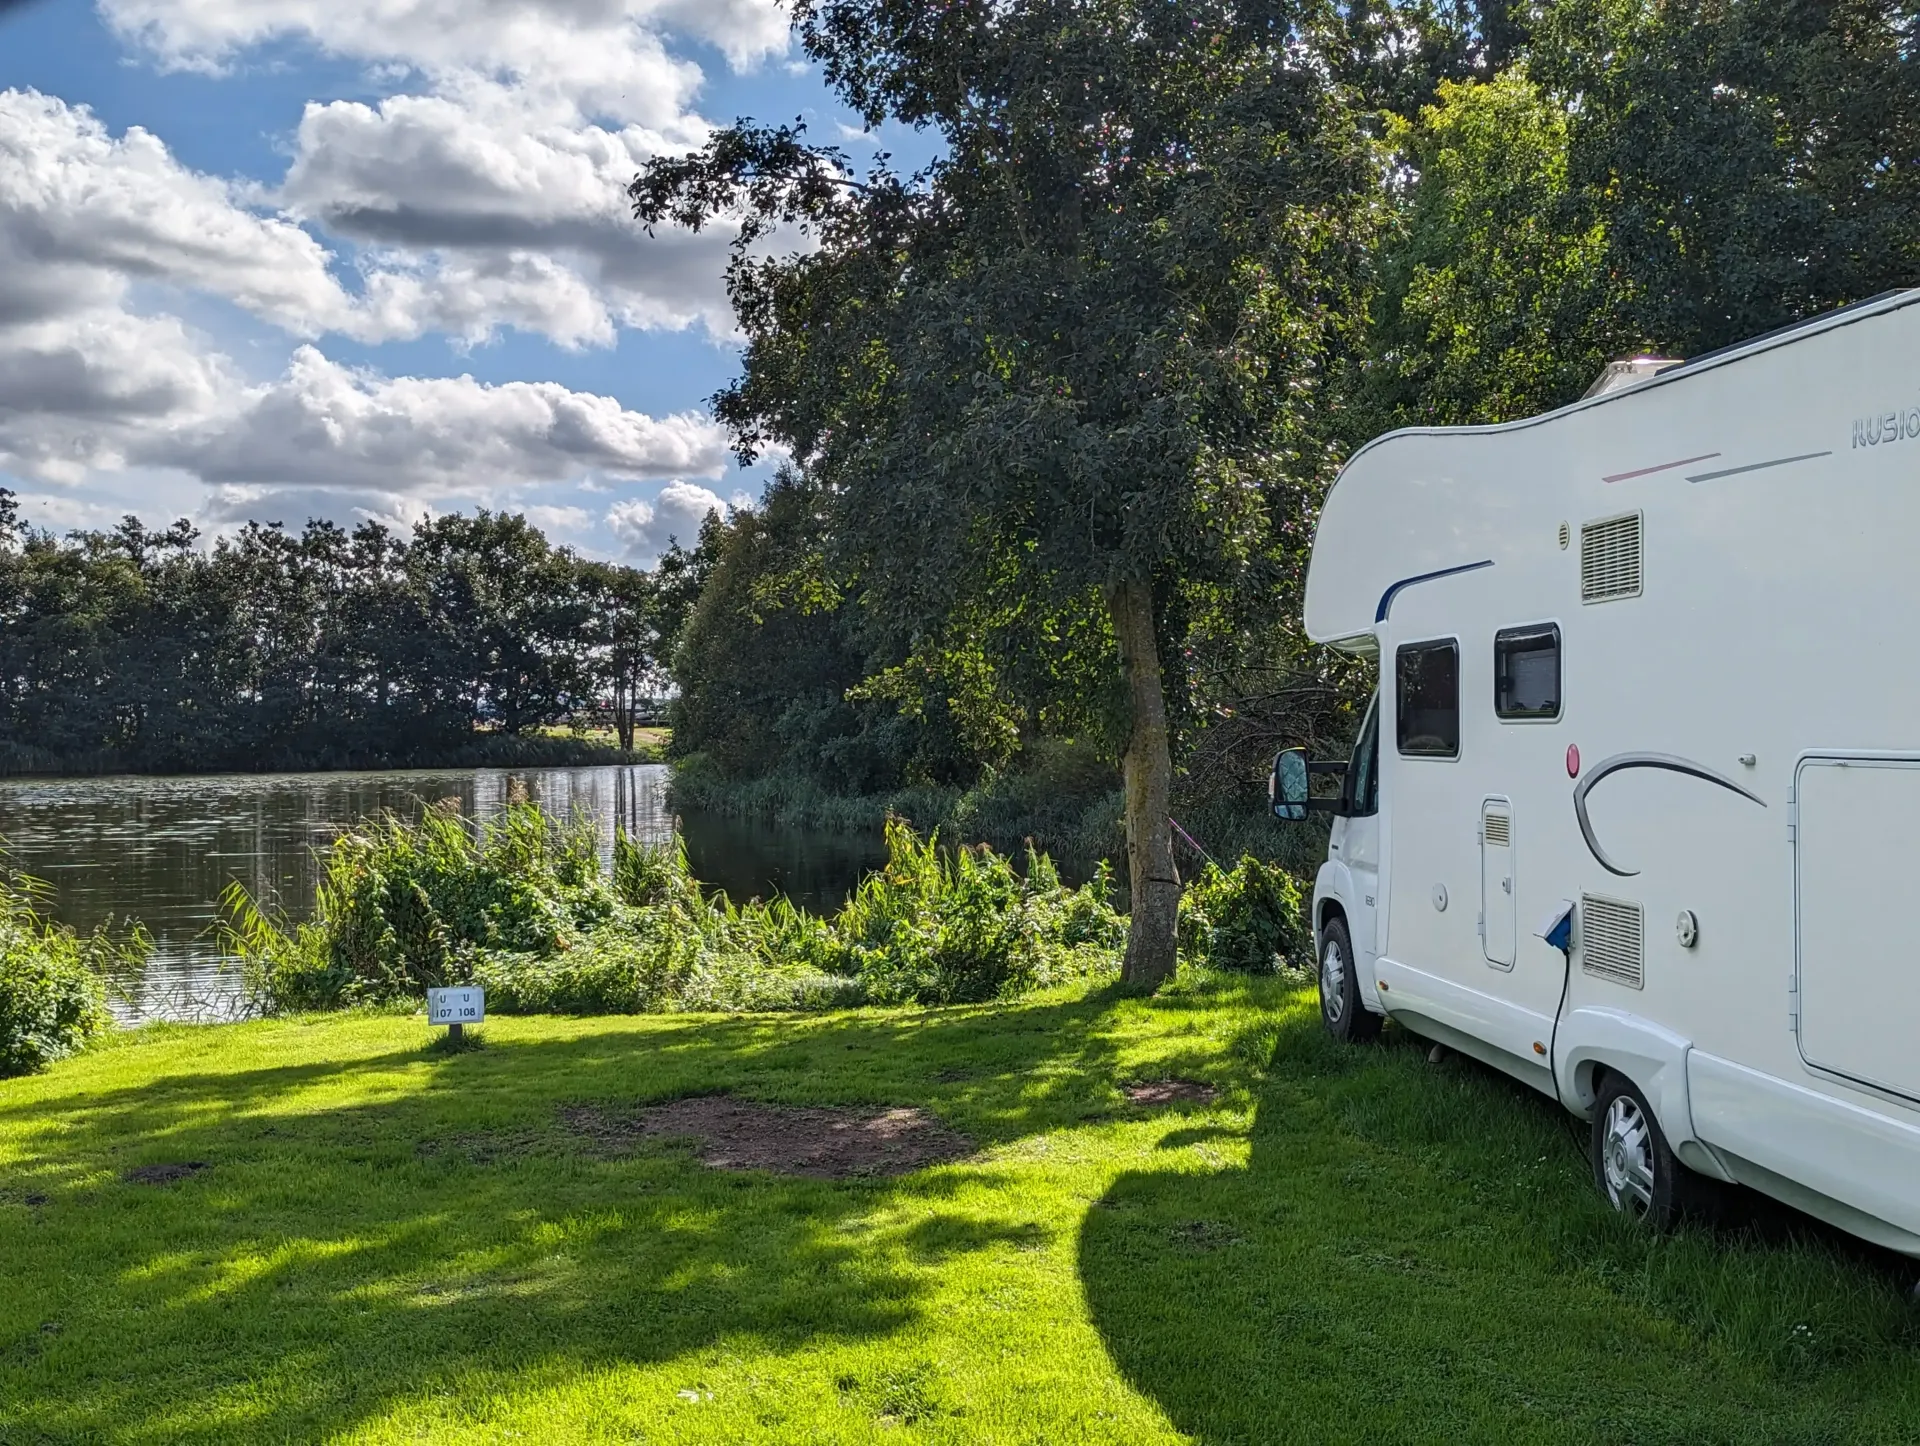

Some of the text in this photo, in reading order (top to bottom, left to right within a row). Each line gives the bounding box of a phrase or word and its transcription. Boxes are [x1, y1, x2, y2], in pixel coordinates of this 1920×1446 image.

[440, 994, 470, 1003] U U
[436, 1007, 476, 1018] 107 108
